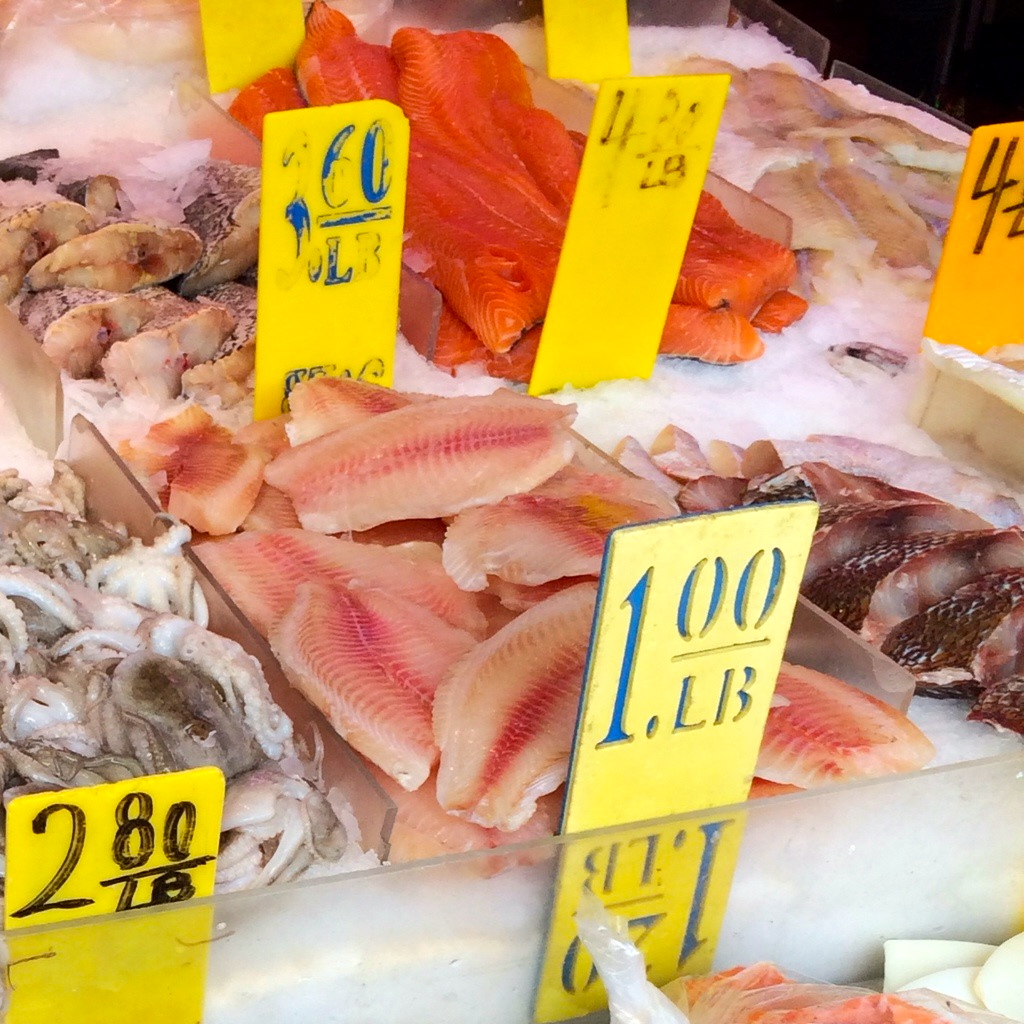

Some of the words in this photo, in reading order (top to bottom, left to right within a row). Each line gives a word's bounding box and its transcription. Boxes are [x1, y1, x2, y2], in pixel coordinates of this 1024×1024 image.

[677, 547, 786, 642] 00
[672, 666, 756, 735] LB
[10, 803, 95, 918] 2
[112, 792, 197, 870] 80
